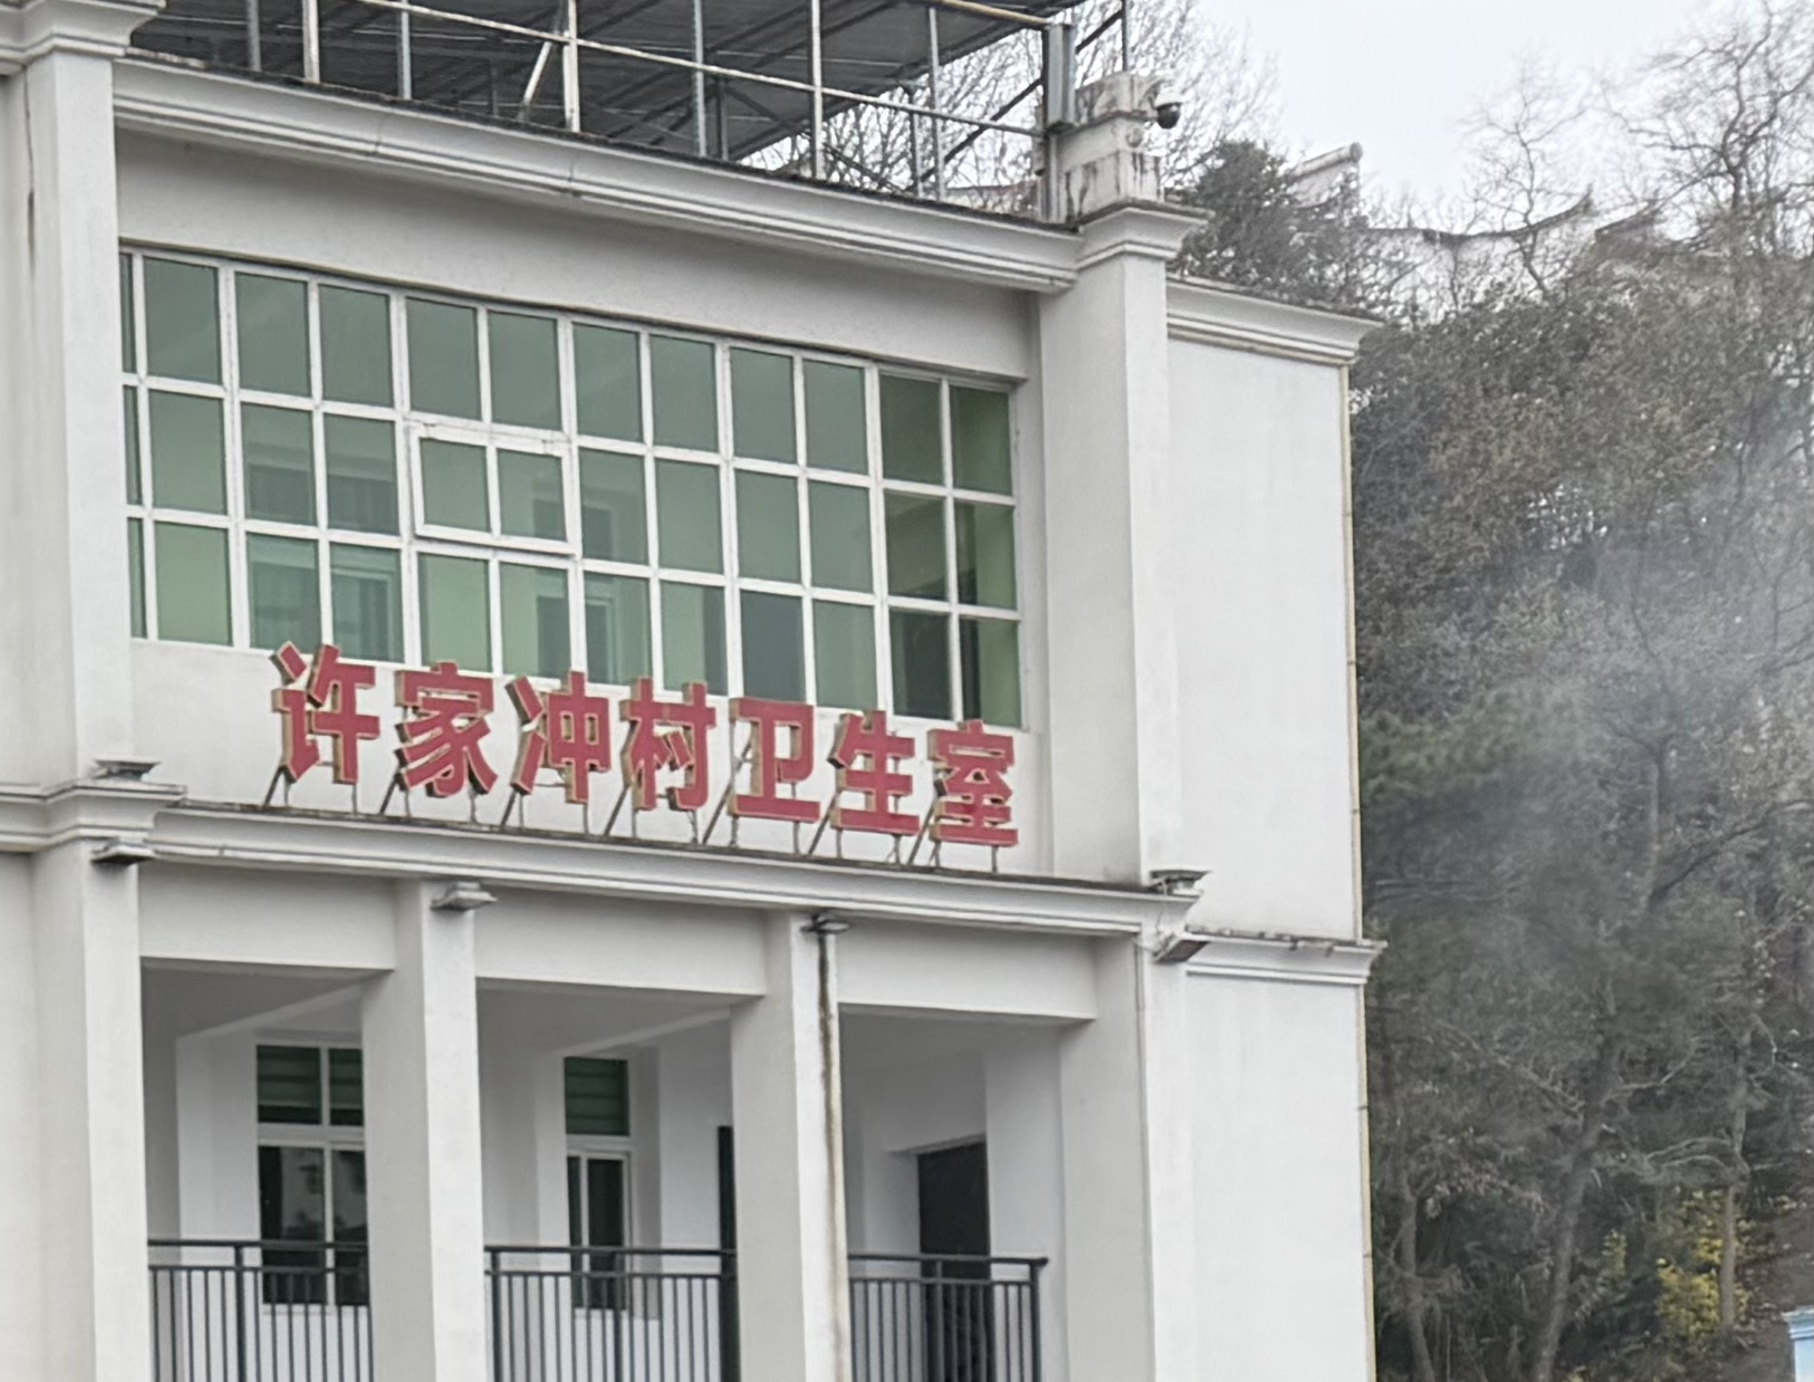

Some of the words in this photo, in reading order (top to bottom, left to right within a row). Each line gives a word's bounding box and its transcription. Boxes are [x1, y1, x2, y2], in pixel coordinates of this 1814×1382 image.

[269, 640, 1019, 848] 许家冲村卫生室
